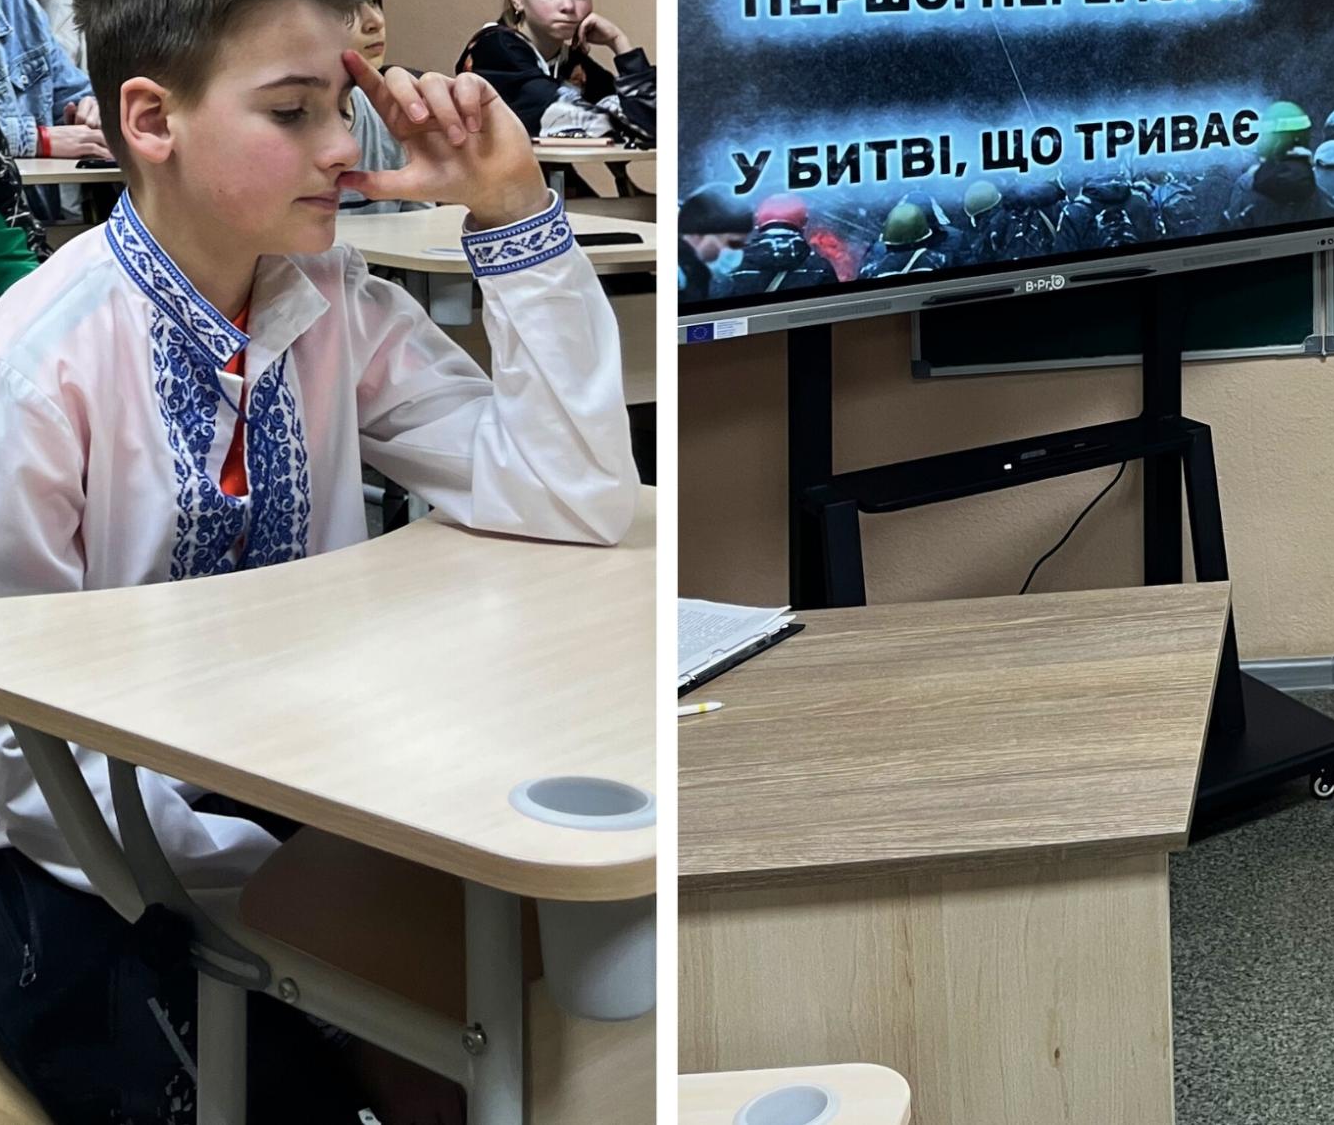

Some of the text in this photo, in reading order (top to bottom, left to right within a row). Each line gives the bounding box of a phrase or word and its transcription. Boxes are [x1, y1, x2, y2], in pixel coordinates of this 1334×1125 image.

[731, 110, 1259, 194] У БИТВІ, ЩО ТРИВАЄ
